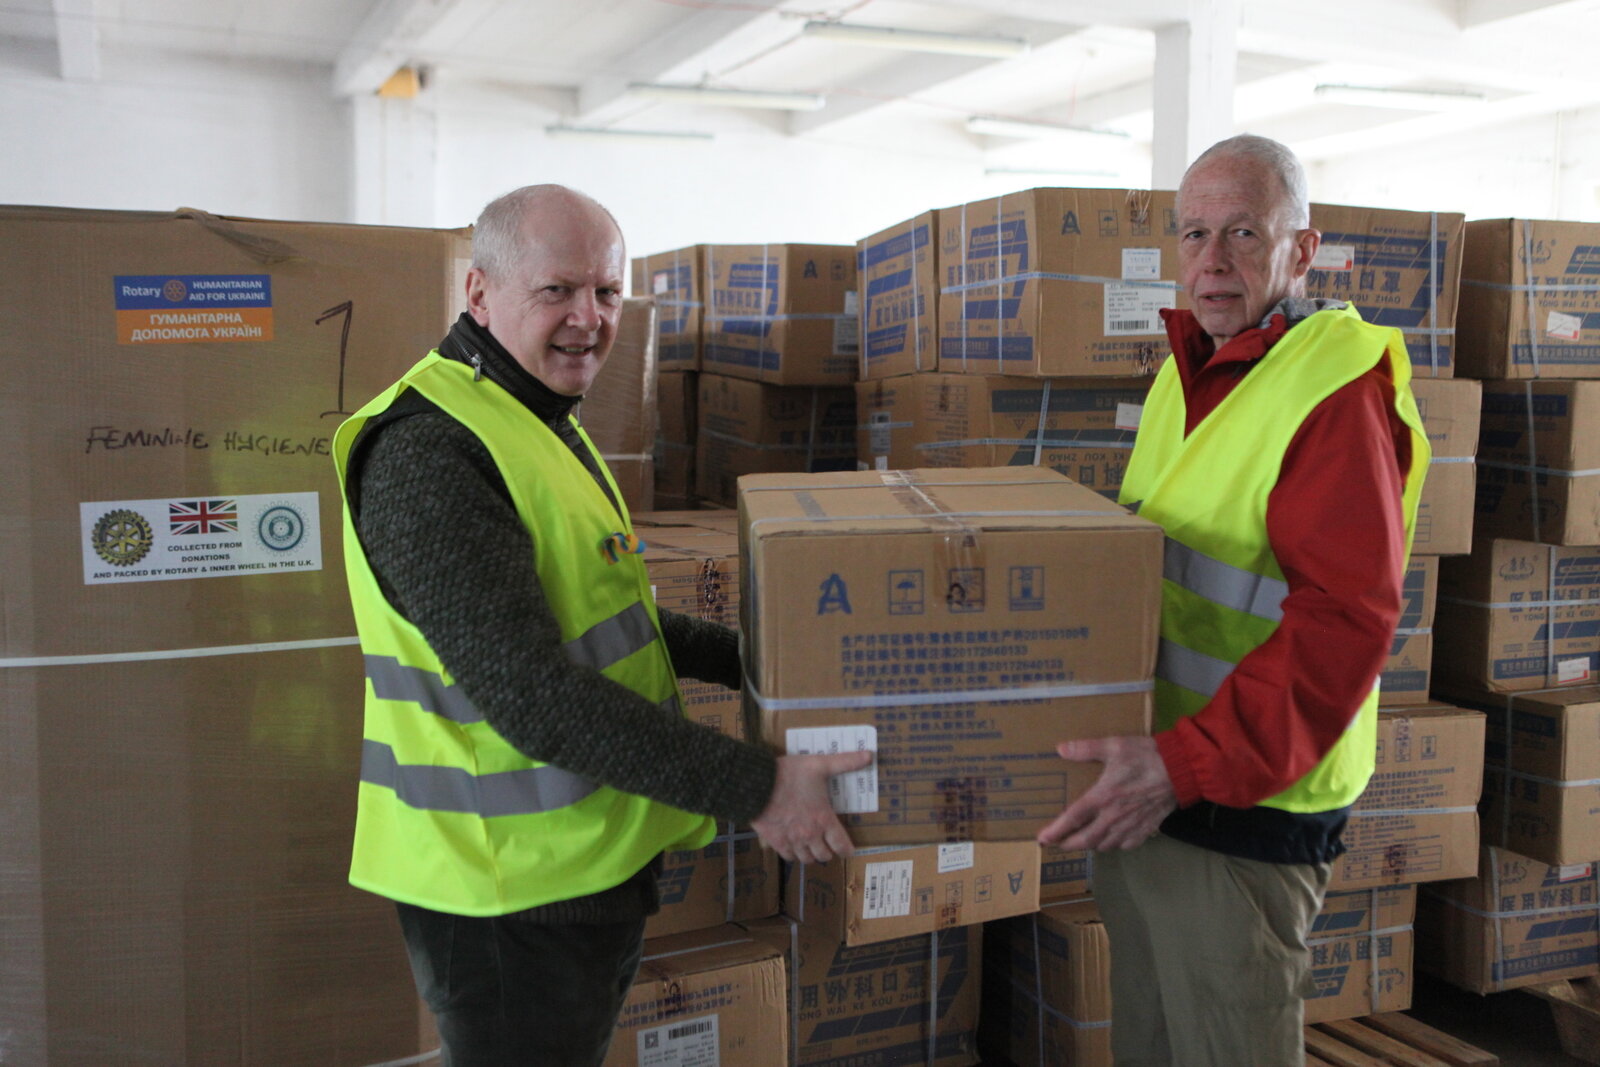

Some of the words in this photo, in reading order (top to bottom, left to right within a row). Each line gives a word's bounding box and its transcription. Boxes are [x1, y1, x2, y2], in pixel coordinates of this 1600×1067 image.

[192, 280, 263, 289] HUMANITARIAN
[121, 285, 162, 298] Rotary
[189, 292, 206, 301] AID
[207, 292, 226, 301] FOR
[227, 291, 266, 300] UKRAINE
[1348, 293, 1369, 302] KOU
[1375, 294, 1401, 304] ZHAO
[150, 312, 243, 325] ГУМАНІТАРНА
[131, 327, 210, 342] ДОПОМОГА
[212, 324, 262, 338] УКРАЇНІ
[85, 425, 209, 454] FEMININE
[223, 431, 330, 456] HYGIENE
[1048, 453, 1078, 463] ZHAO
[1084, 452, 1106, 461] KOU
[167, 543, 217, 552] COLLECTED
[181, 554, 231, 563] DONATIONS
[93, 571, 112, 579] AND
[114, 569, 149, 578] PACKED
[165, 567, 199, 575] ROTARY
[209, 564, 236, 572] INNER
[238, 562, 266, 570] WHEEL
[297, 559, 314, 567] U.K.
[816, 572, 853, 615] A
[799, 965, 925, 1009] 用外科口罩
[799, 1011, 822, 1021] ONG
[827, 1006, 847, 1016] WAI
[871, 996, 893, 1007] KOU
